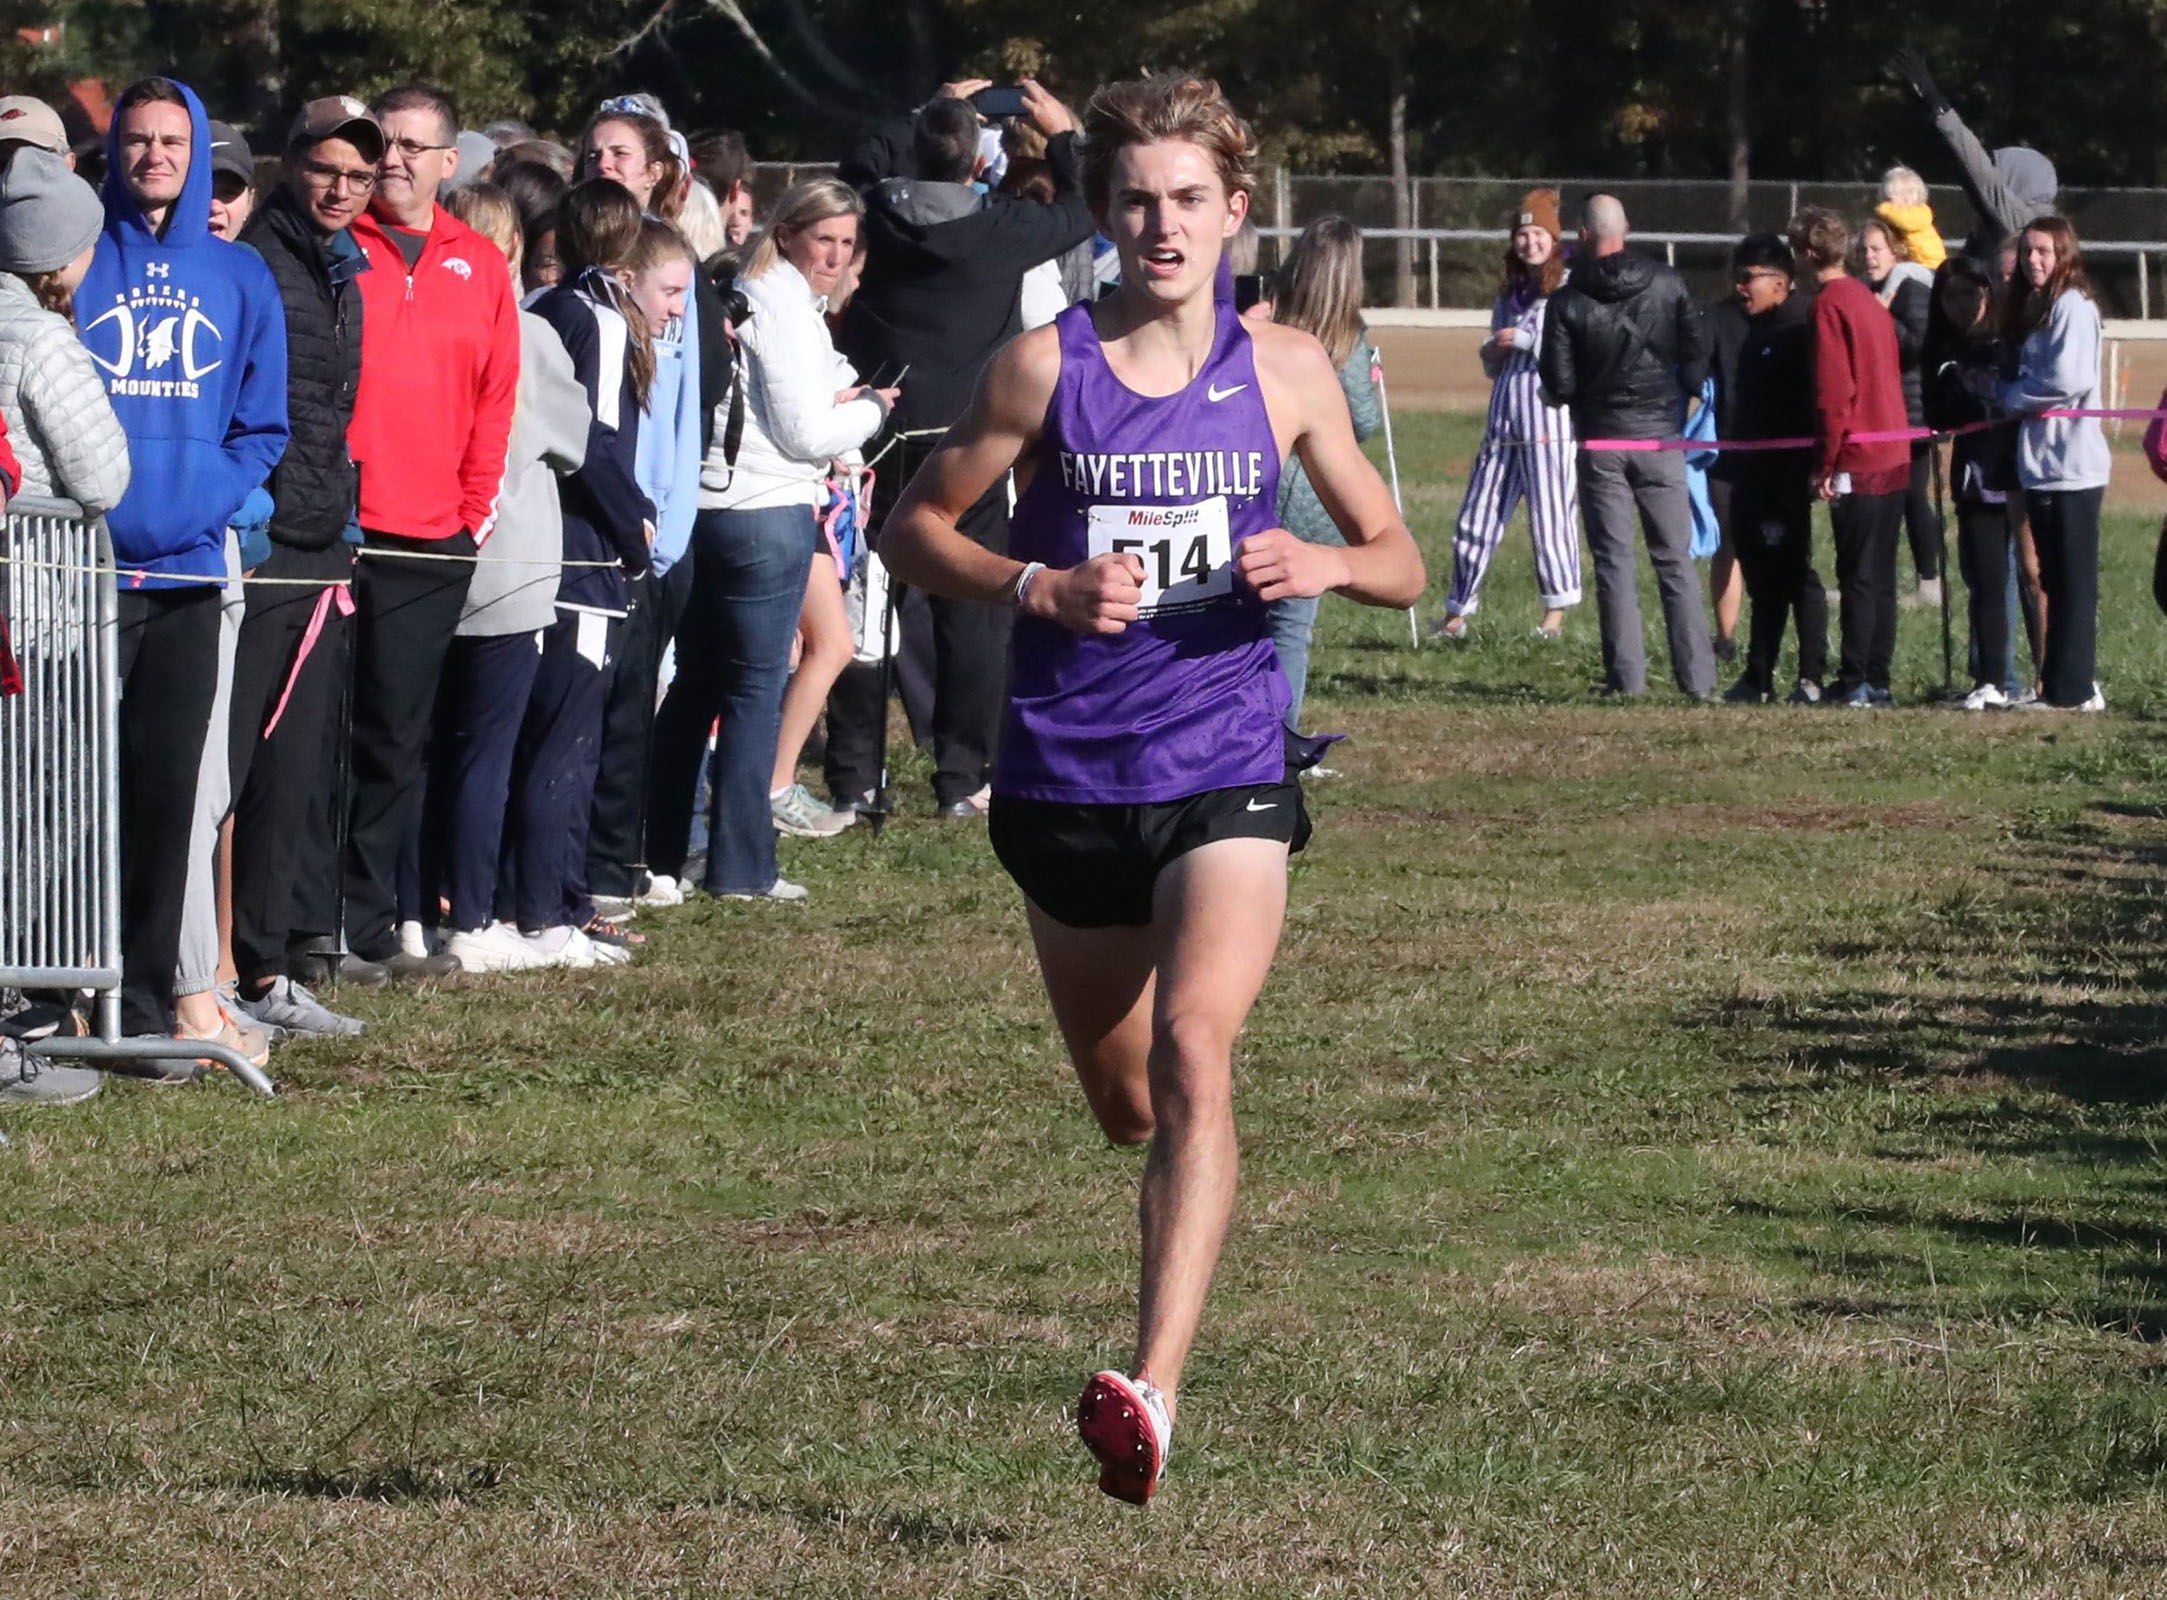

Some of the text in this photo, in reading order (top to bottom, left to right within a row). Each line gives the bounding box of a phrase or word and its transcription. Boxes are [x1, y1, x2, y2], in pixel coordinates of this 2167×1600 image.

[116, 283, 200, 308] ROGERS
[111, 379, 199, 399] MOUNTIES
[1060, 451, 1262, 498] FAYETTEVILLE
[1128, 509, 1199, 528] MileSplit
